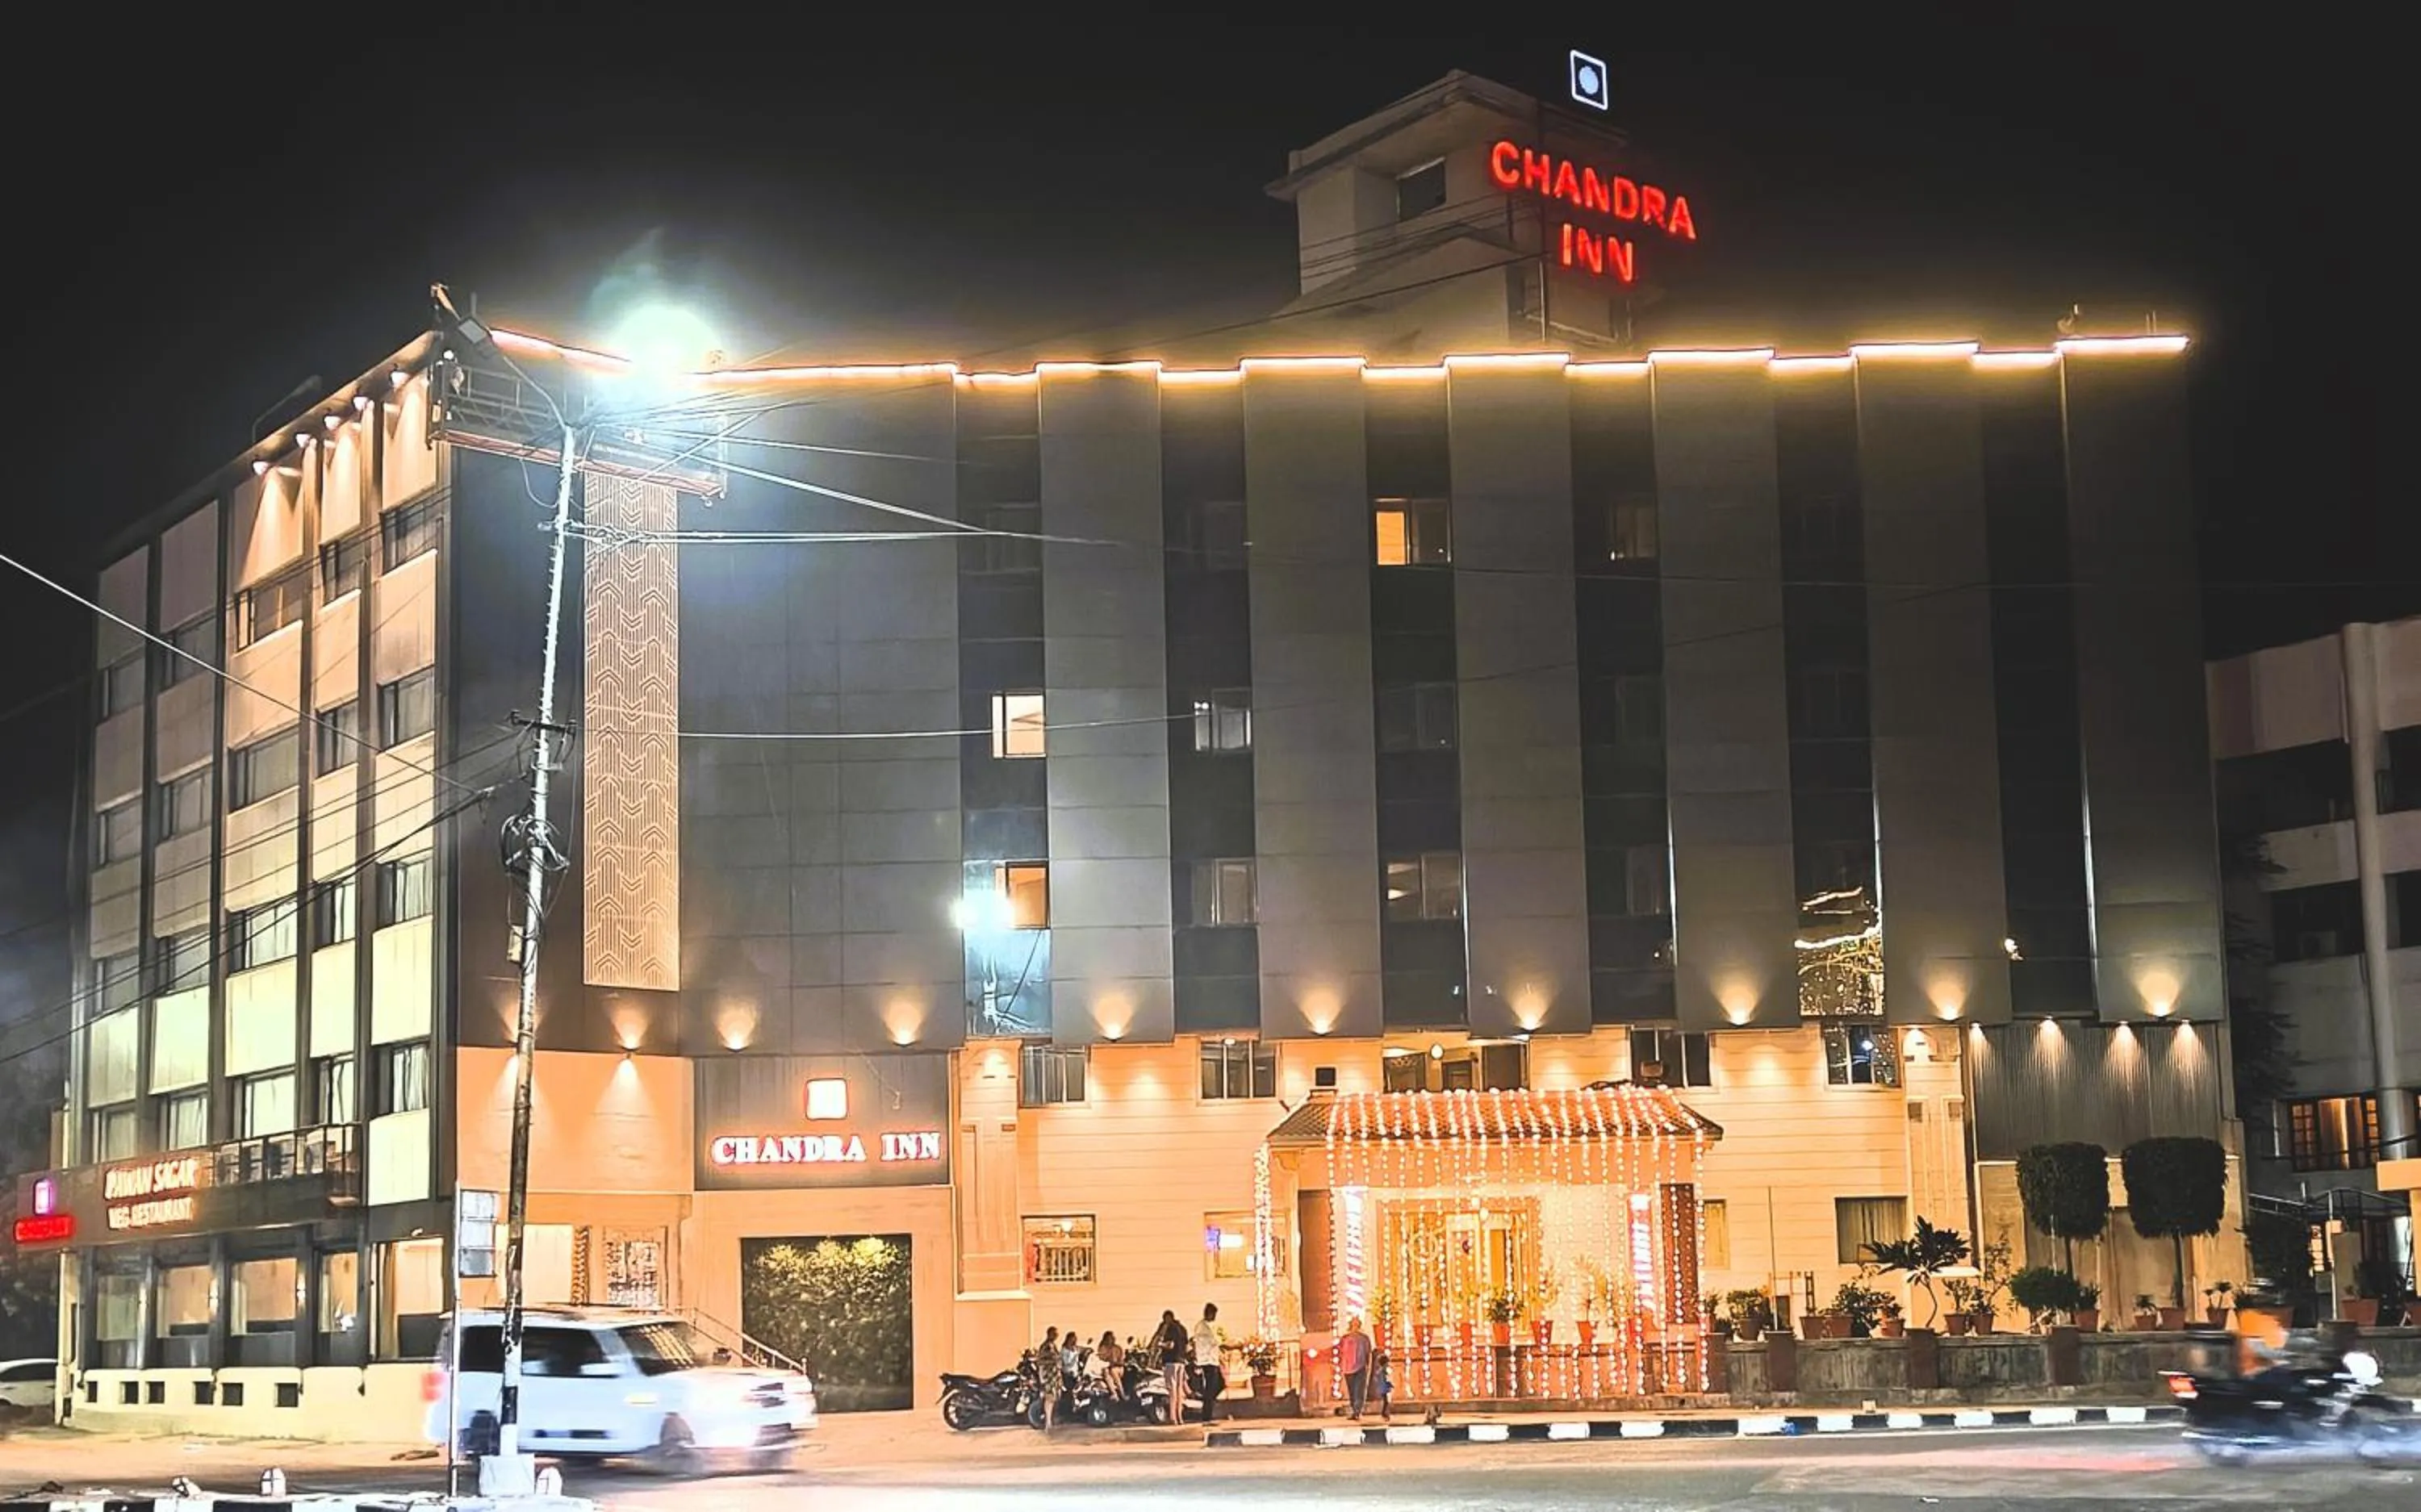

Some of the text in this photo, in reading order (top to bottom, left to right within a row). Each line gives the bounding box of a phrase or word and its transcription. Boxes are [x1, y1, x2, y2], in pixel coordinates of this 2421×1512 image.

[1491, 140, 1696, 240] CHANDRA
[1562, 222, 1633, 282] INN
[711, 1131, 941, 1163] CHANDRA INN
